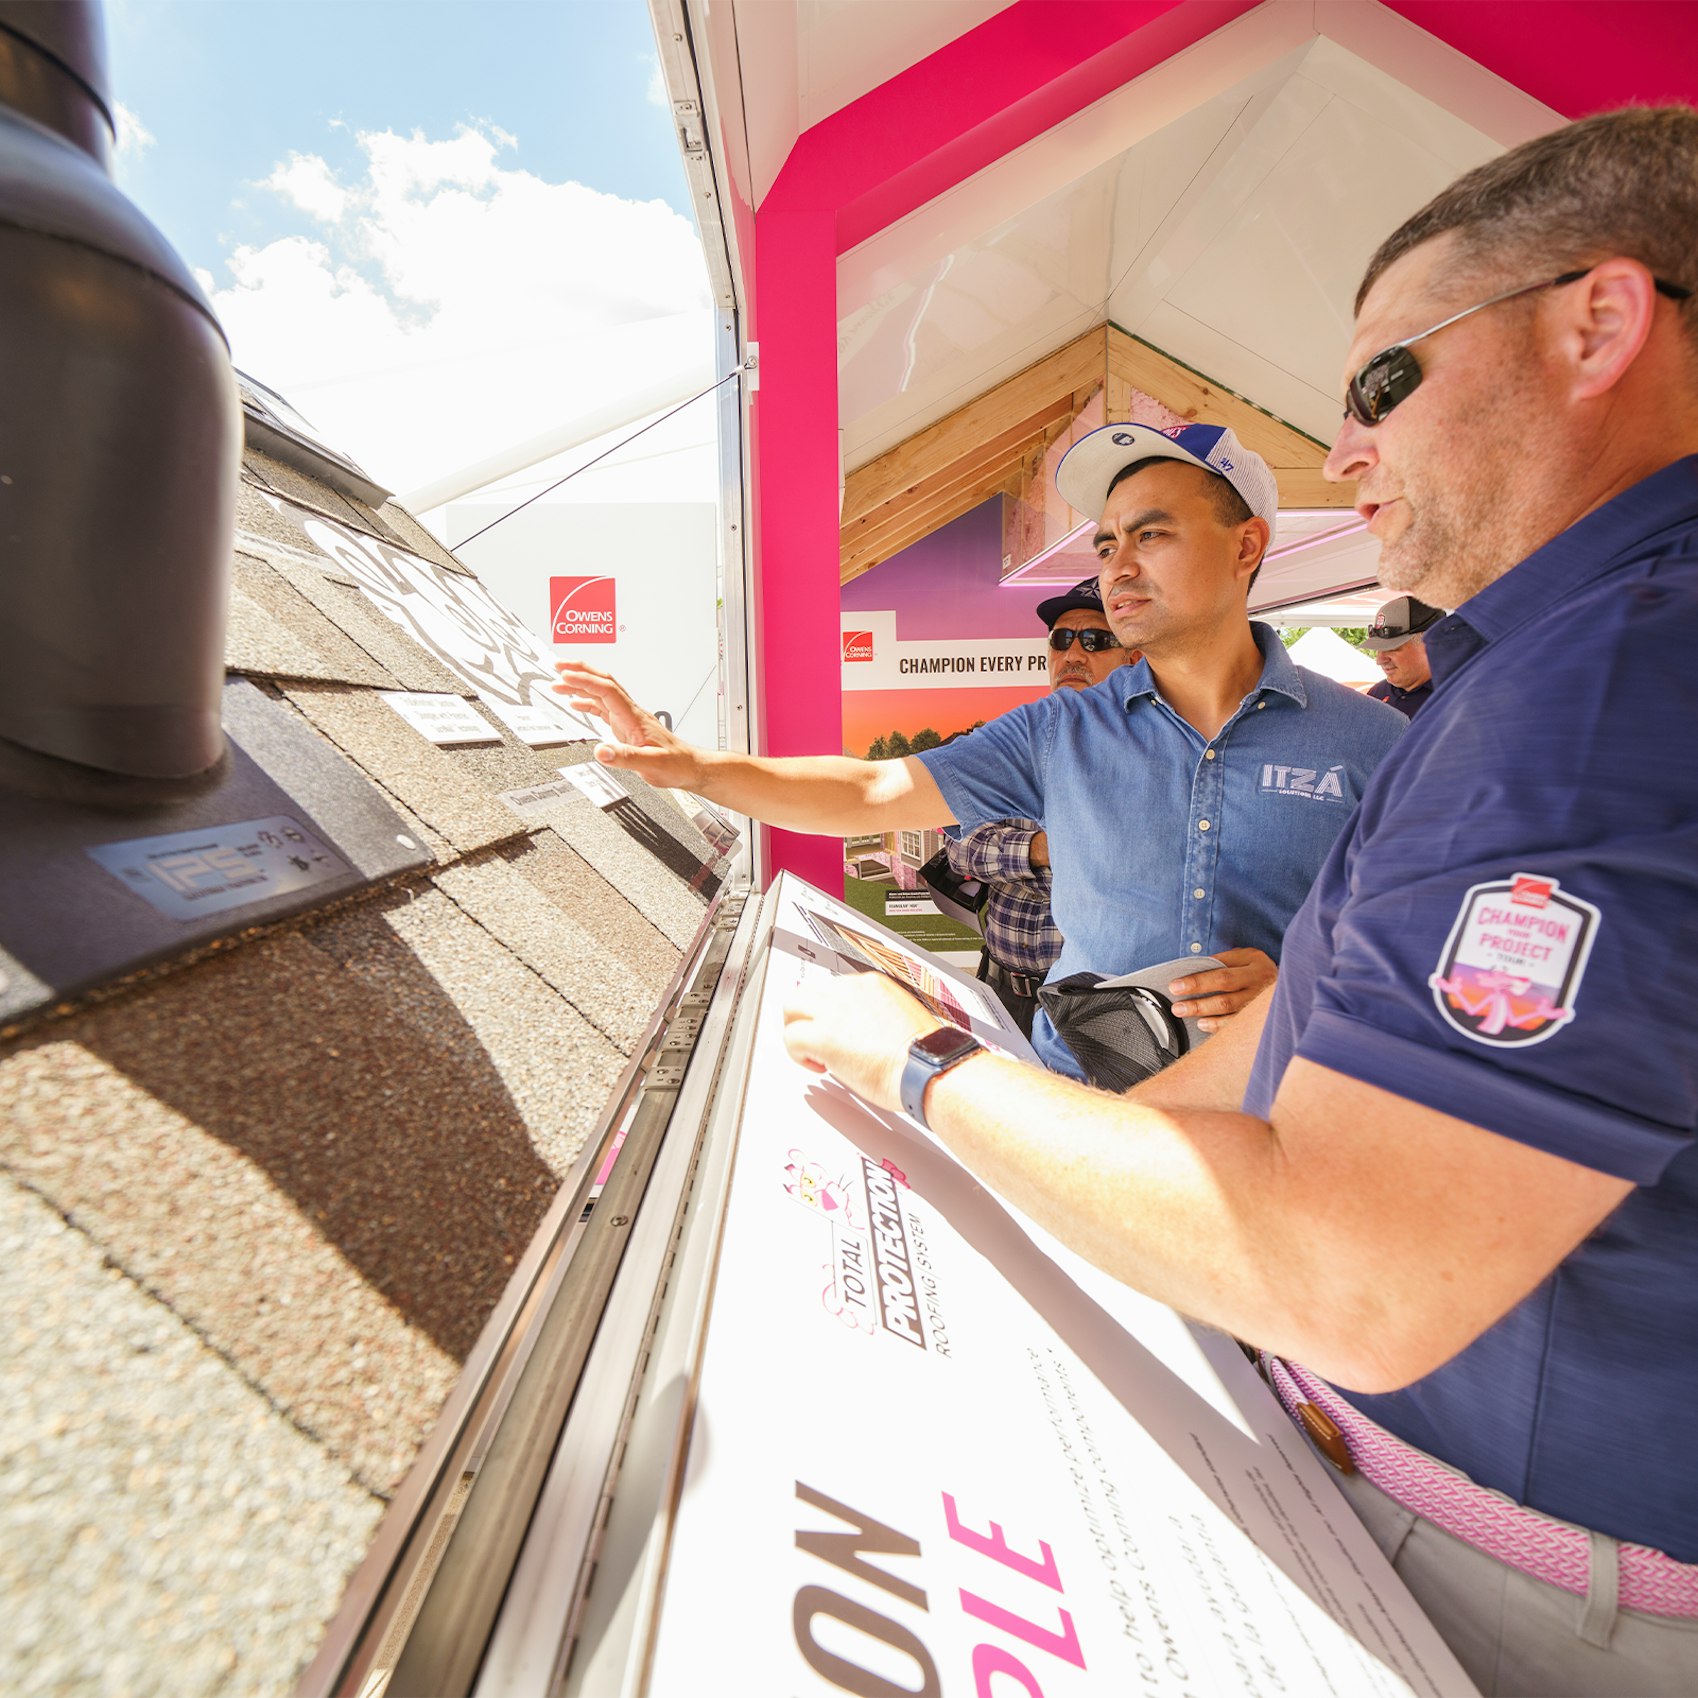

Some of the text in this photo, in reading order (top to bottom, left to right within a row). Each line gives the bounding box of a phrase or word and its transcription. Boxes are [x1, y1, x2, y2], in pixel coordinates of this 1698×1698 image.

[556, 621, 613, 635] CORNING
[566, 609, 613, 622] OWENS
[899, 657, 975, 674] CHAMPION
[980, 656, 1023, 672] EVERY
[1262, 764, 1344, 798] ITZÁ
[1477, 906, 1571, 944] CHAMPION
[1479, 933, 1554, 961] PROJECT
[864, 1160, 923, 1346] PROTECTION
[840, 1238, 867, 1308] TOTAL
[907, 1212, 952, 1359] ROOFING SYSTEM
[1109, 1579, 1144, 1643] help
[1138, 1579, 1190, 1681] Owens
